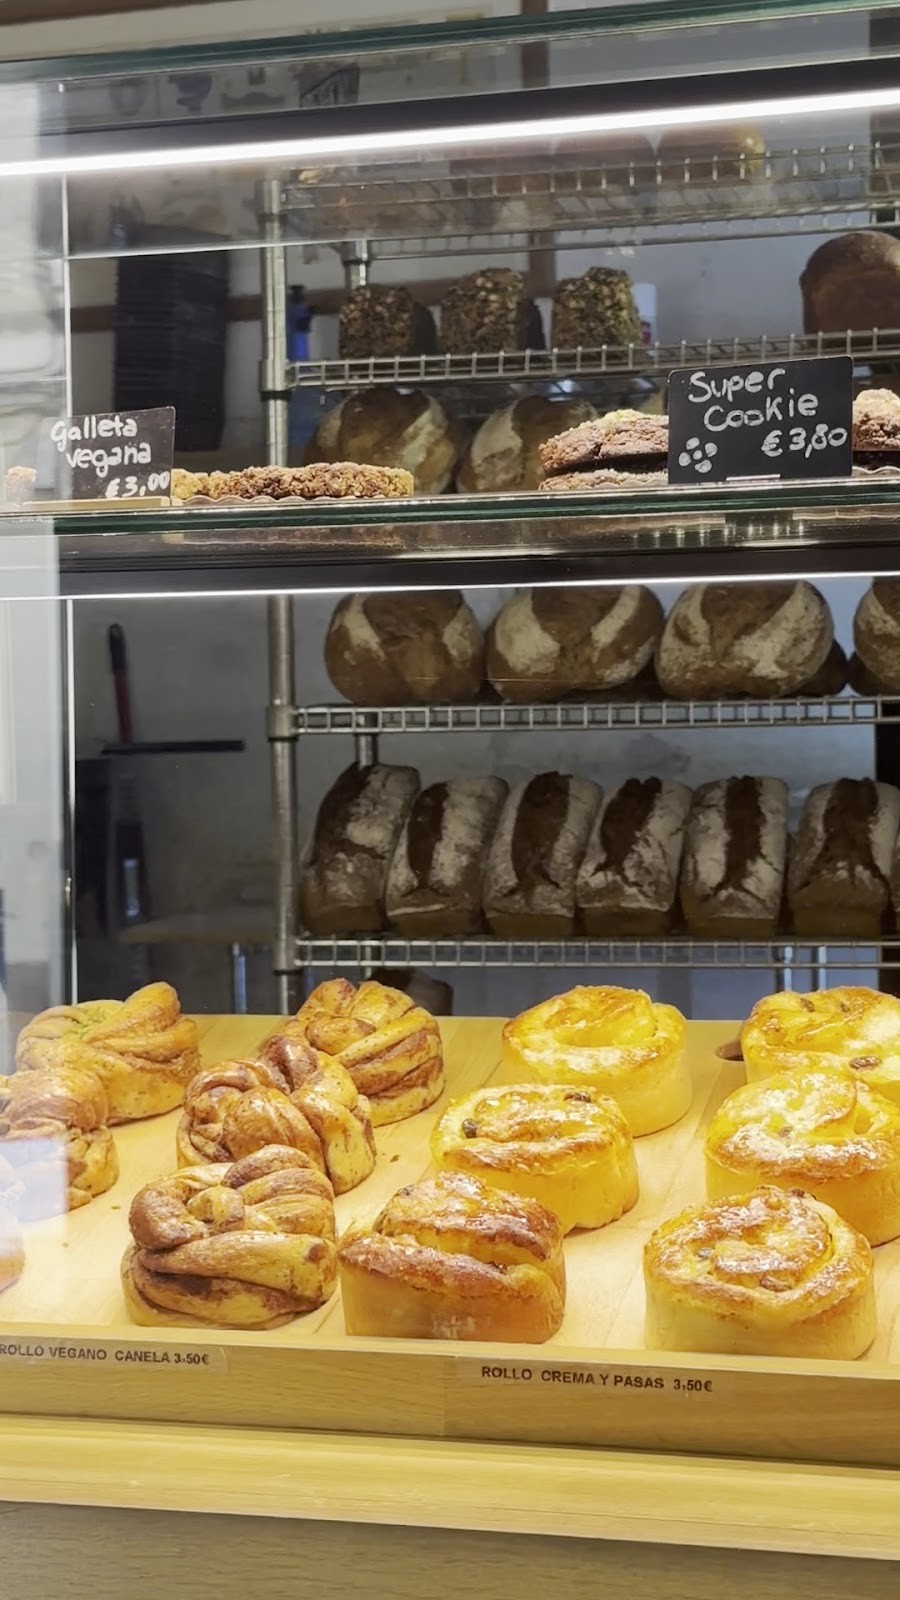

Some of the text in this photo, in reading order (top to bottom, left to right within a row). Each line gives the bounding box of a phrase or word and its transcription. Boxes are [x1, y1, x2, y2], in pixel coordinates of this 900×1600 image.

[688, 368, 786, 403] Super
[761, 424, 848, 459] €3,80
[0, 1344, 45, 1357] ROLLO
[49, 1346, 107, 1361] VEGANO
[114, 1350, 171, 1364] CANELA
[481, 1366, 533, 1381] ROLLO
[541, 1370, 595, 1385] CREMA
[599, 1374, 609, 1386] Y
[613, 1375, 665, 1389] PASAS
